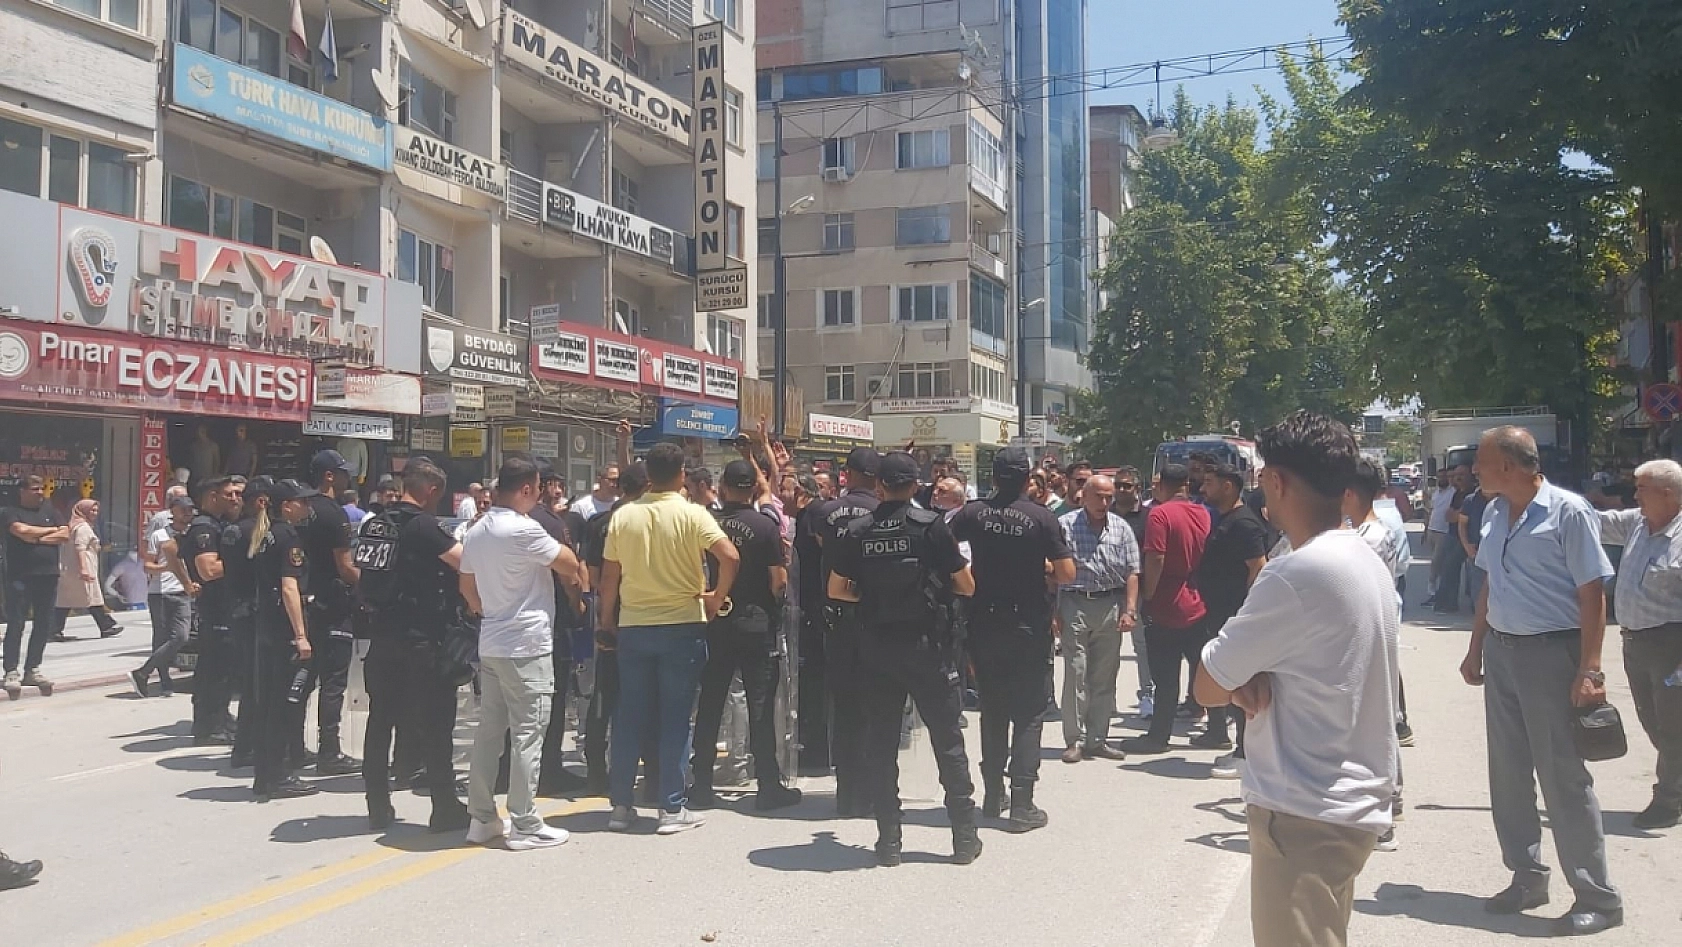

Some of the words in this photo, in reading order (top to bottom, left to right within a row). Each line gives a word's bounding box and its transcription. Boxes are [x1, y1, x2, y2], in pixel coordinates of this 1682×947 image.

[512, 22, 692, 134] MARATON
[278, 88, 321, 125] HAVA
[618, 101, 668, 132] KURSU
[409, 136, 495, 178] AVUKAT
[698, 44, 719, 255] MARATON
[596, 204, 631, 229] AVUKAT
[618, 226, 648, 253] KAYA
[140, 230, 371, 311] HAYAT
[703, 285, 740, 297] KURSU
[465, 333, 517, 356] BEYDAĞI
[40, 331, 114, 364] Pınar
[118, 346, 307, 403] ECZANESİ
[460, 351, 522, 374] GÜVENLİK
[335, 421, 353, 431] KOT
[813, 421, 831, 432] KENT
